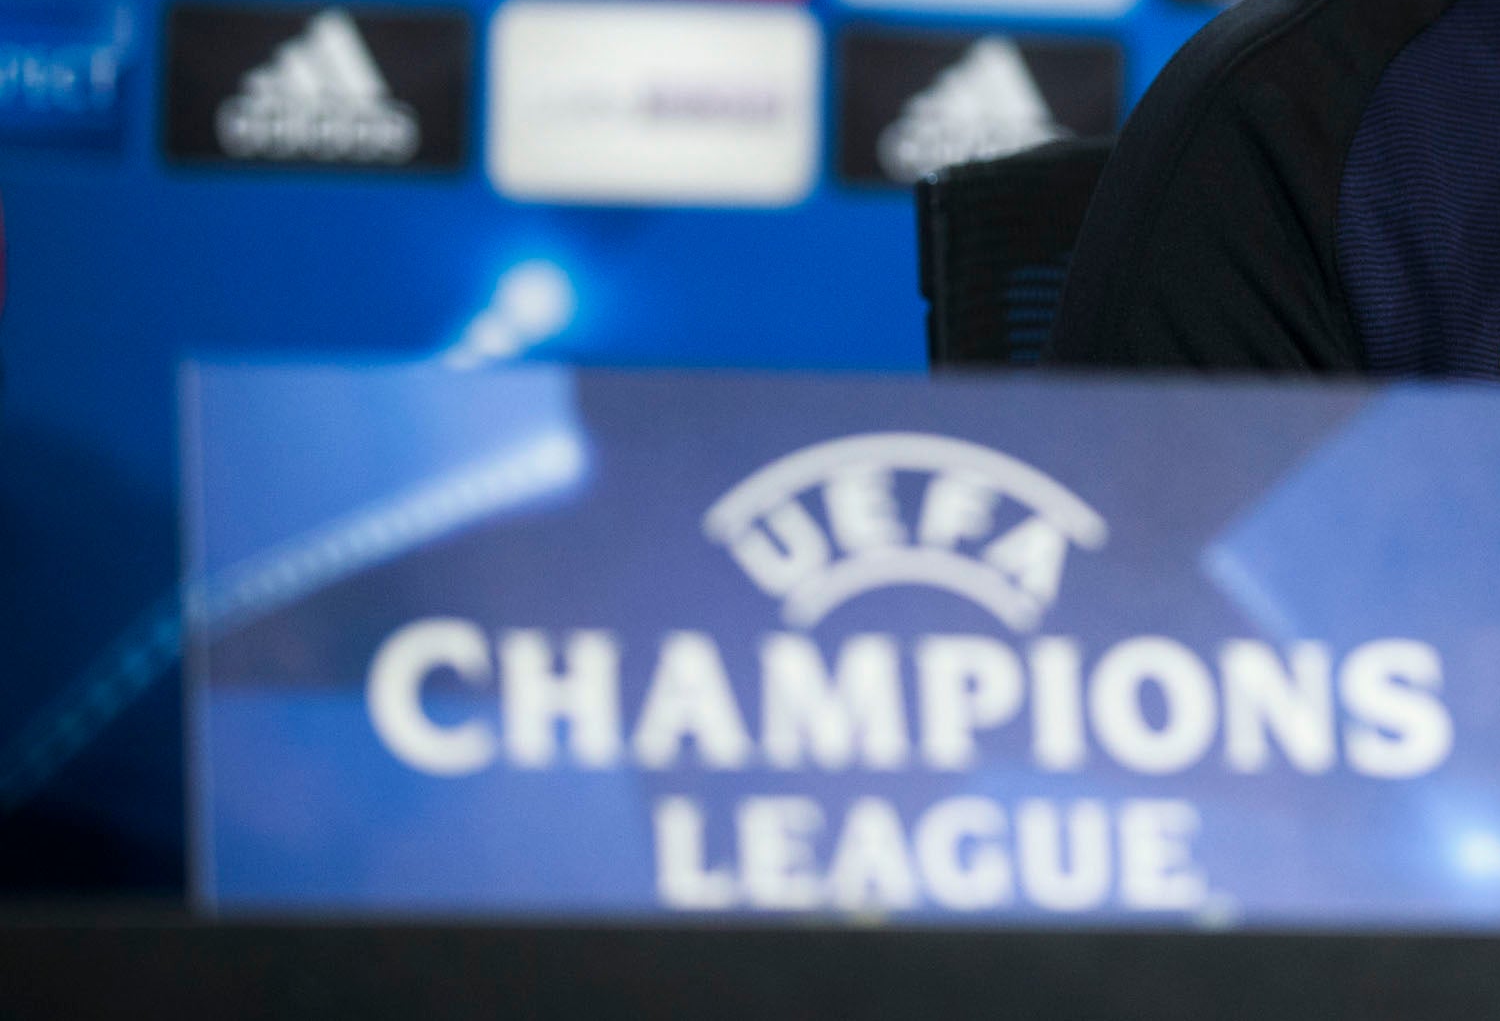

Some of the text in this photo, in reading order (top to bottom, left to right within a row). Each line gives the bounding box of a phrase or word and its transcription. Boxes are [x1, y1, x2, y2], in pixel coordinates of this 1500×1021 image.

[722, 468, 1070, 602] UEFA
[367, 618, 1454, 776] CHAMPIONS
[654, 794, 1208, 913] LEAGUE
